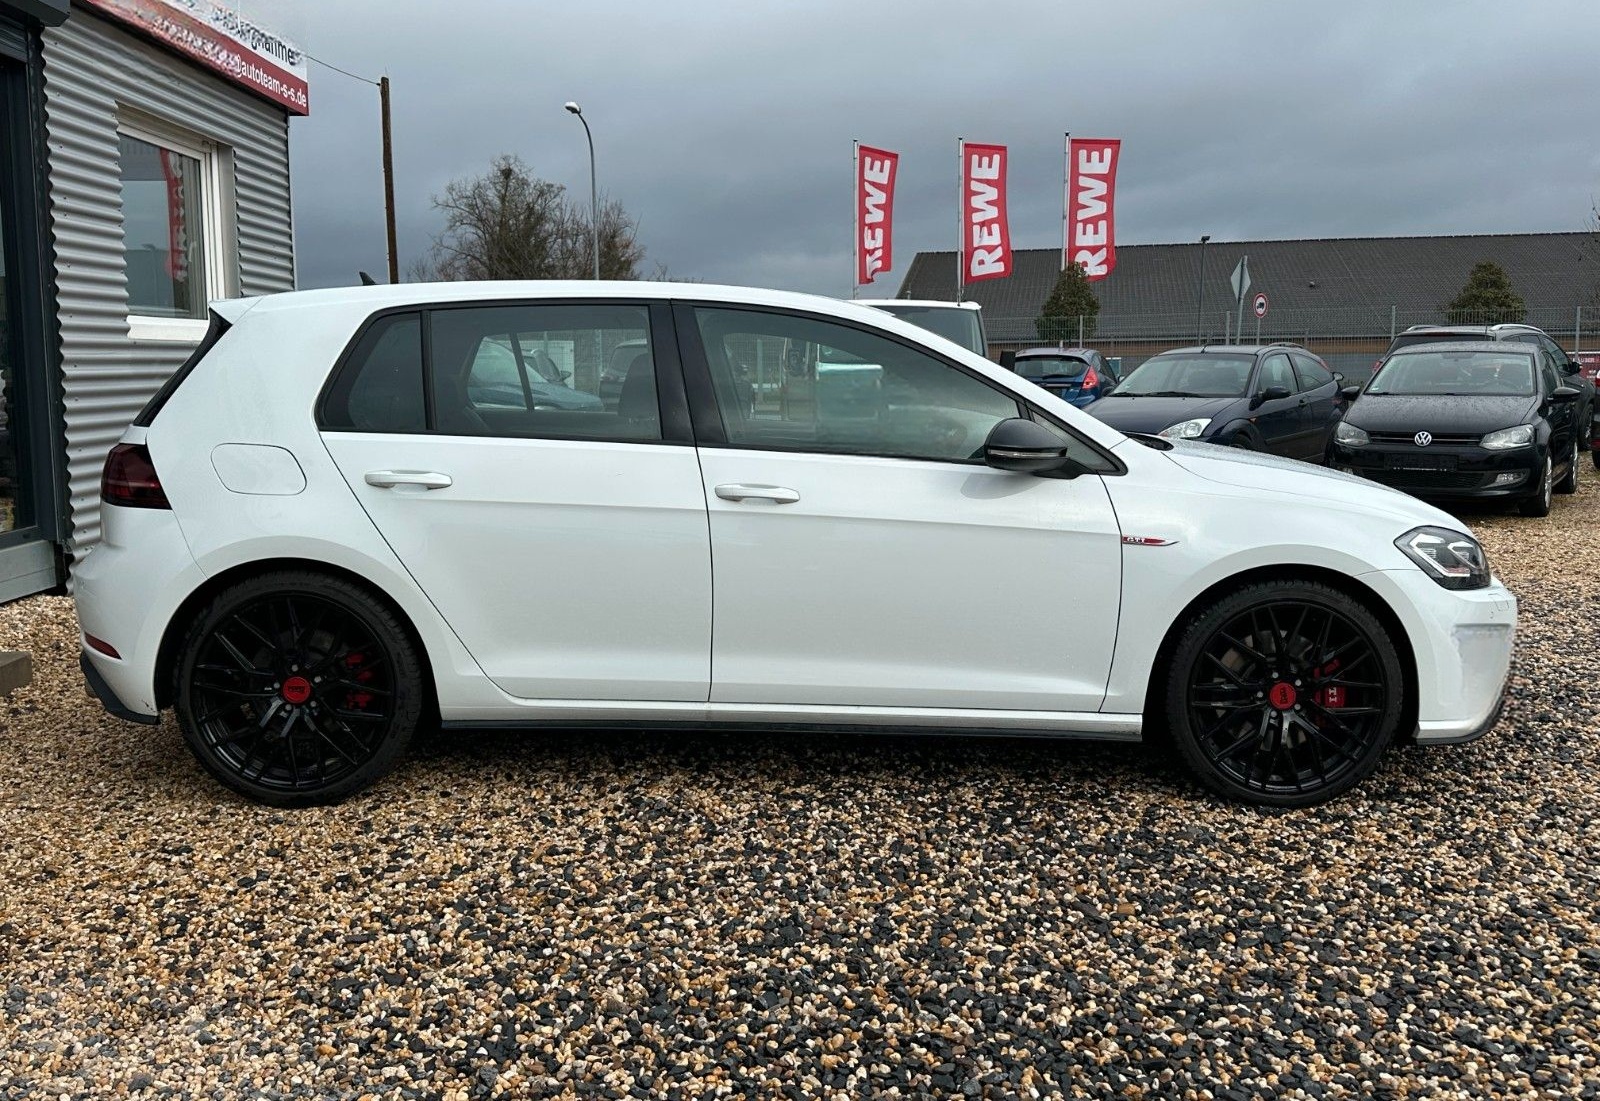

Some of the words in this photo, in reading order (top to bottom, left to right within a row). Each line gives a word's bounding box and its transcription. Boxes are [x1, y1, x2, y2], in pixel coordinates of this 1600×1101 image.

[970, 154, 1005, 277] REWE
[1075, 148, 1112, 276] REWE
[1415, 431, 1432, 447] VW
